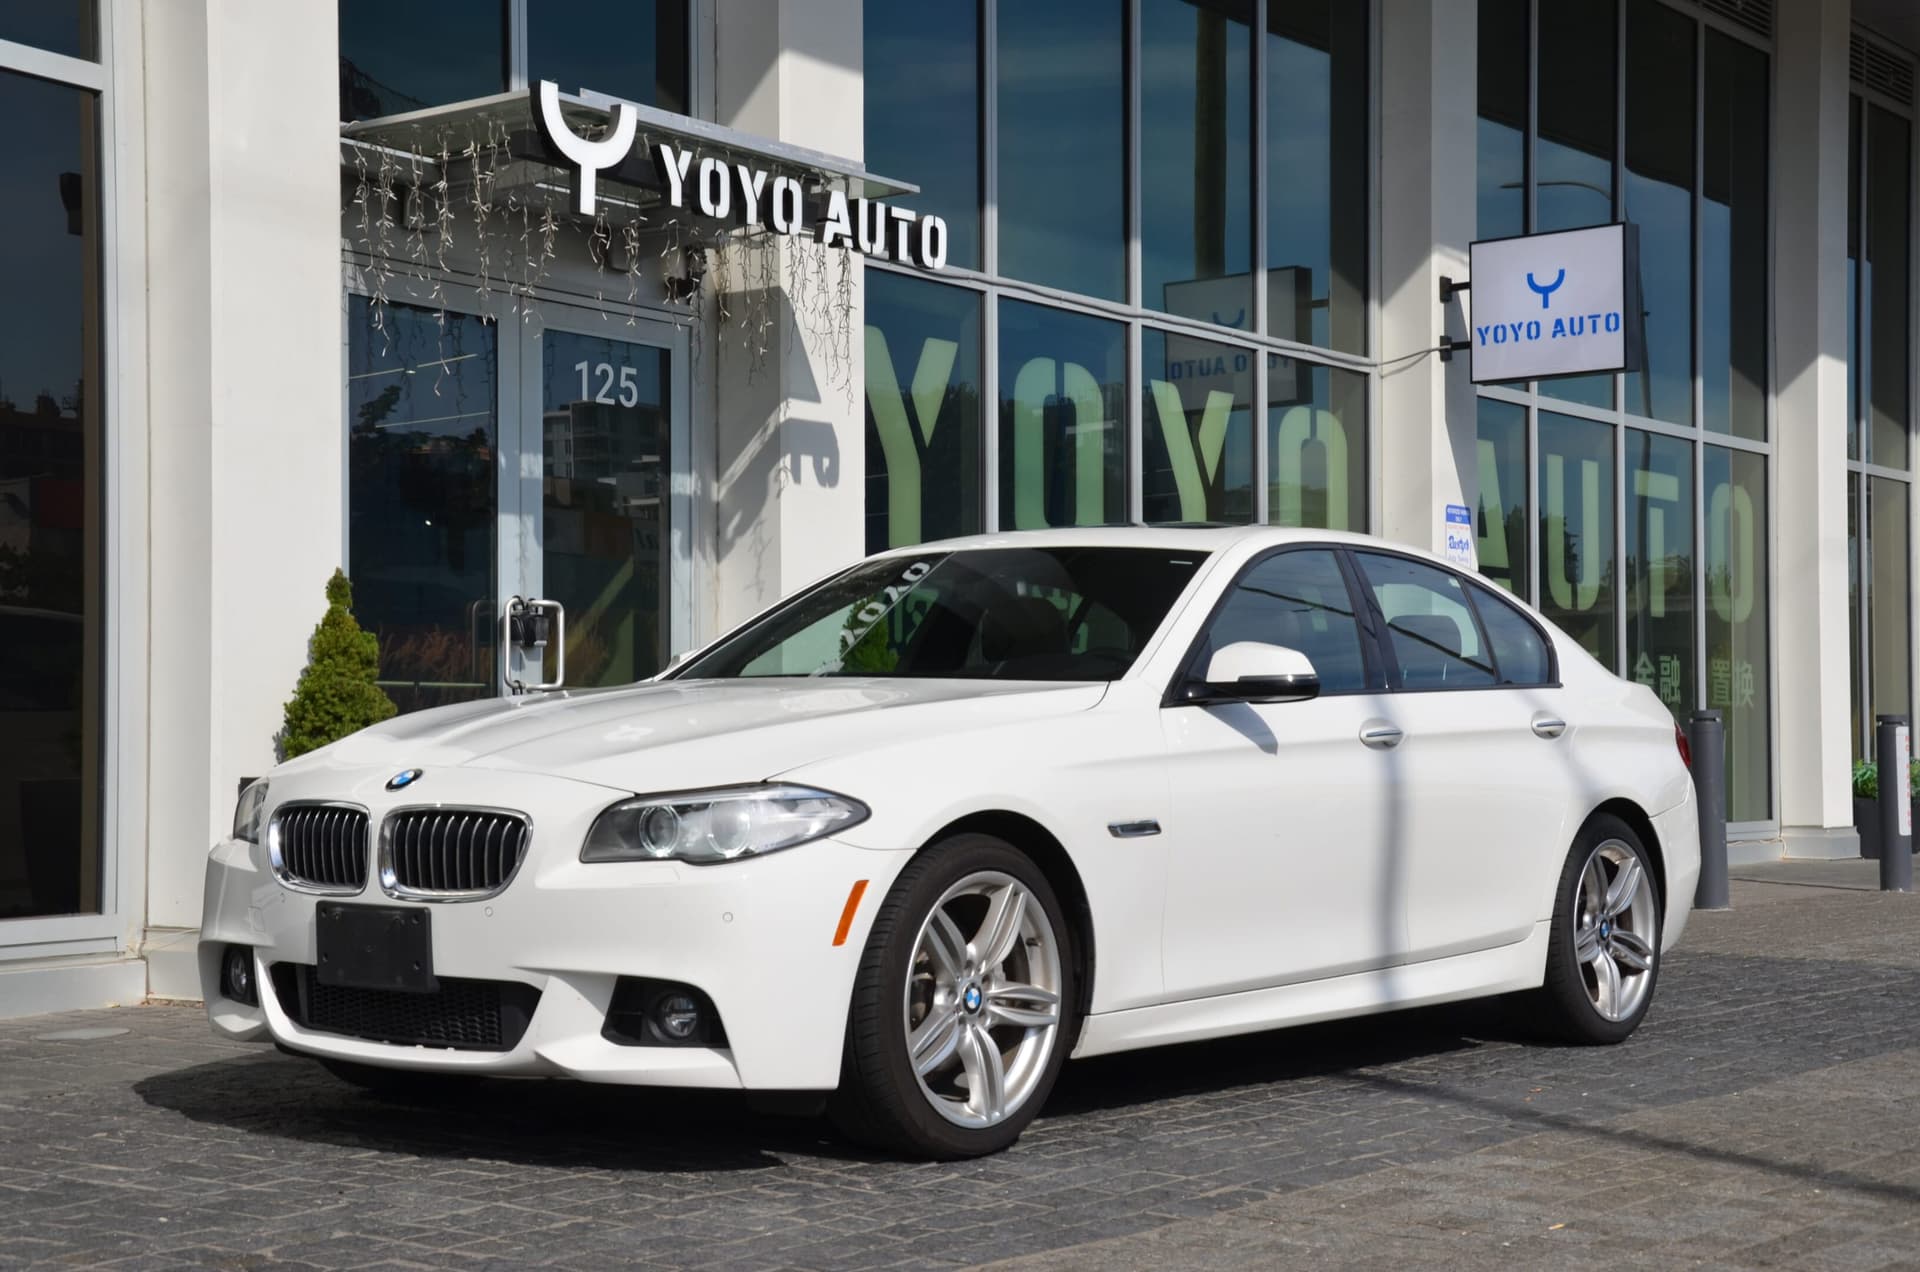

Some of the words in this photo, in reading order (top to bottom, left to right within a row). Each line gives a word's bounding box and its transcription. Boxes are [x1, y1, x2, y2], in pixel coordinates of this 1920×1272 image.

[660, 143, 802, 235] YOYO
[822, 190, 948, 269] AUTO
[1476, 320, 1541, 346] YOYO
[1551, 311, 1620, 338] AUTO
[574, 360, 638, 409] 125
